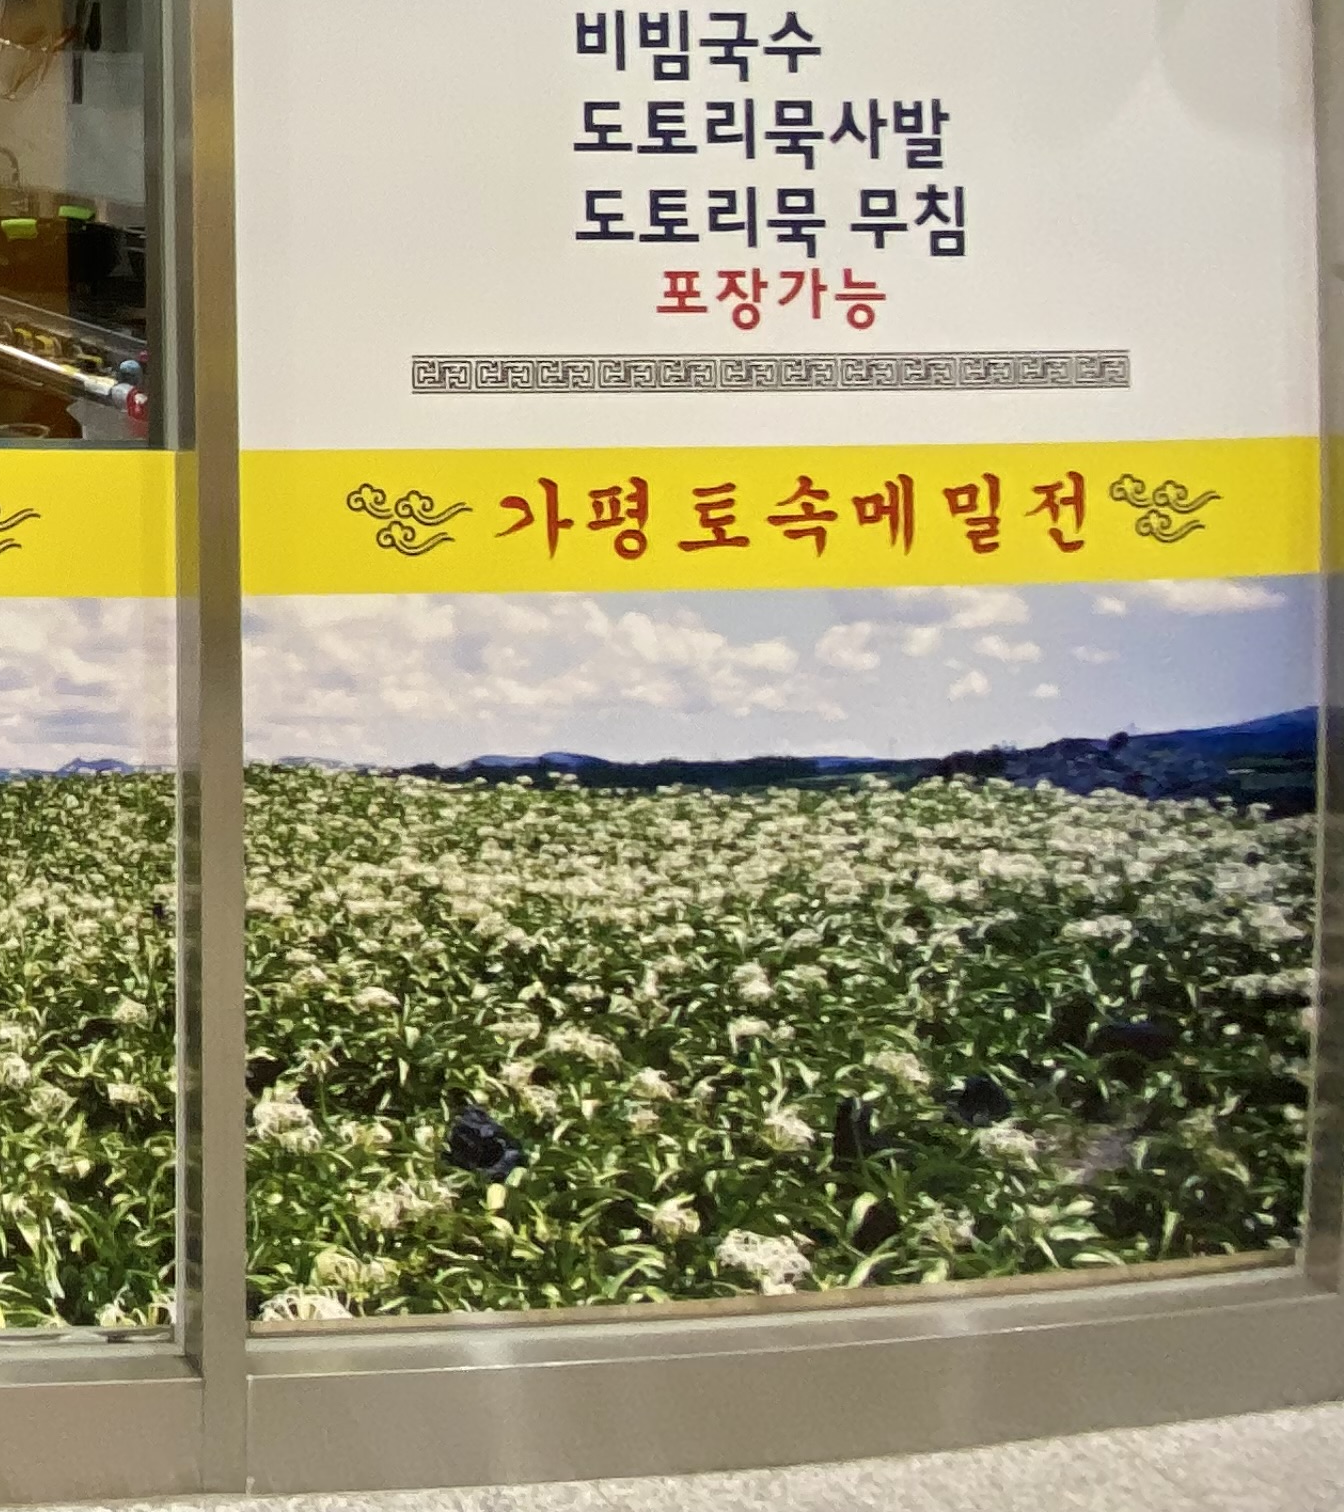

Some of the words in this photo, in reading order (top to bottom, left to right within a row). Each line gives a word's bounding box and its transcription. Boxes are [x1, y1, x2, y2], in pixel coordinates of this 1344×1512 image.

[576, 9, 821, 82] 비빔국수
[573, 98, 950, 170] 도토리묵사발
[575, 186, 826, 259] 도토리묵
[850, 185, 967, 257] 무침
[656, 267, 887, 331] 포장가능
